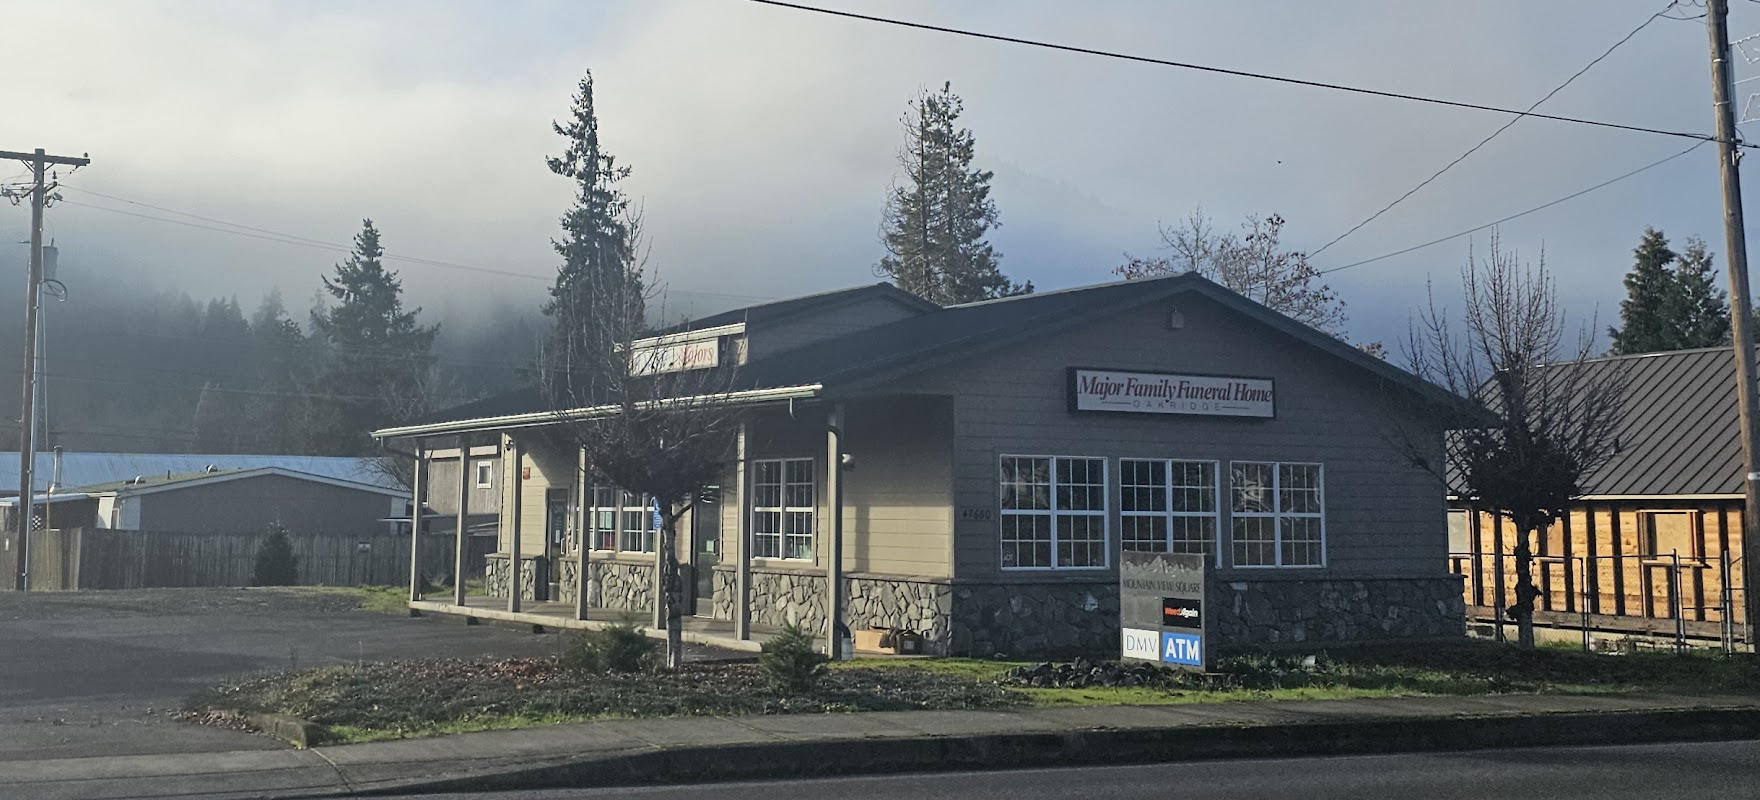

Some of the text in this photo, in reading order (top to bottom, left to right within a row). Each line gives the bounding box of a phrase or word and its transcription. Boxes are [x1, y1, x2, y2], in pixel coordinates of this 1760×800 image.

[1079, 376, 1273, 403] Major Family Funeral Home
[1133, 400, 1220, 411] OAKRIDGE
[1122, 579, 1201, 595] MOUNTAIN VIEW SQUARE
[1126, 634, 1157, 653] DMV
[1165, 637, 1199, 661] ATM
